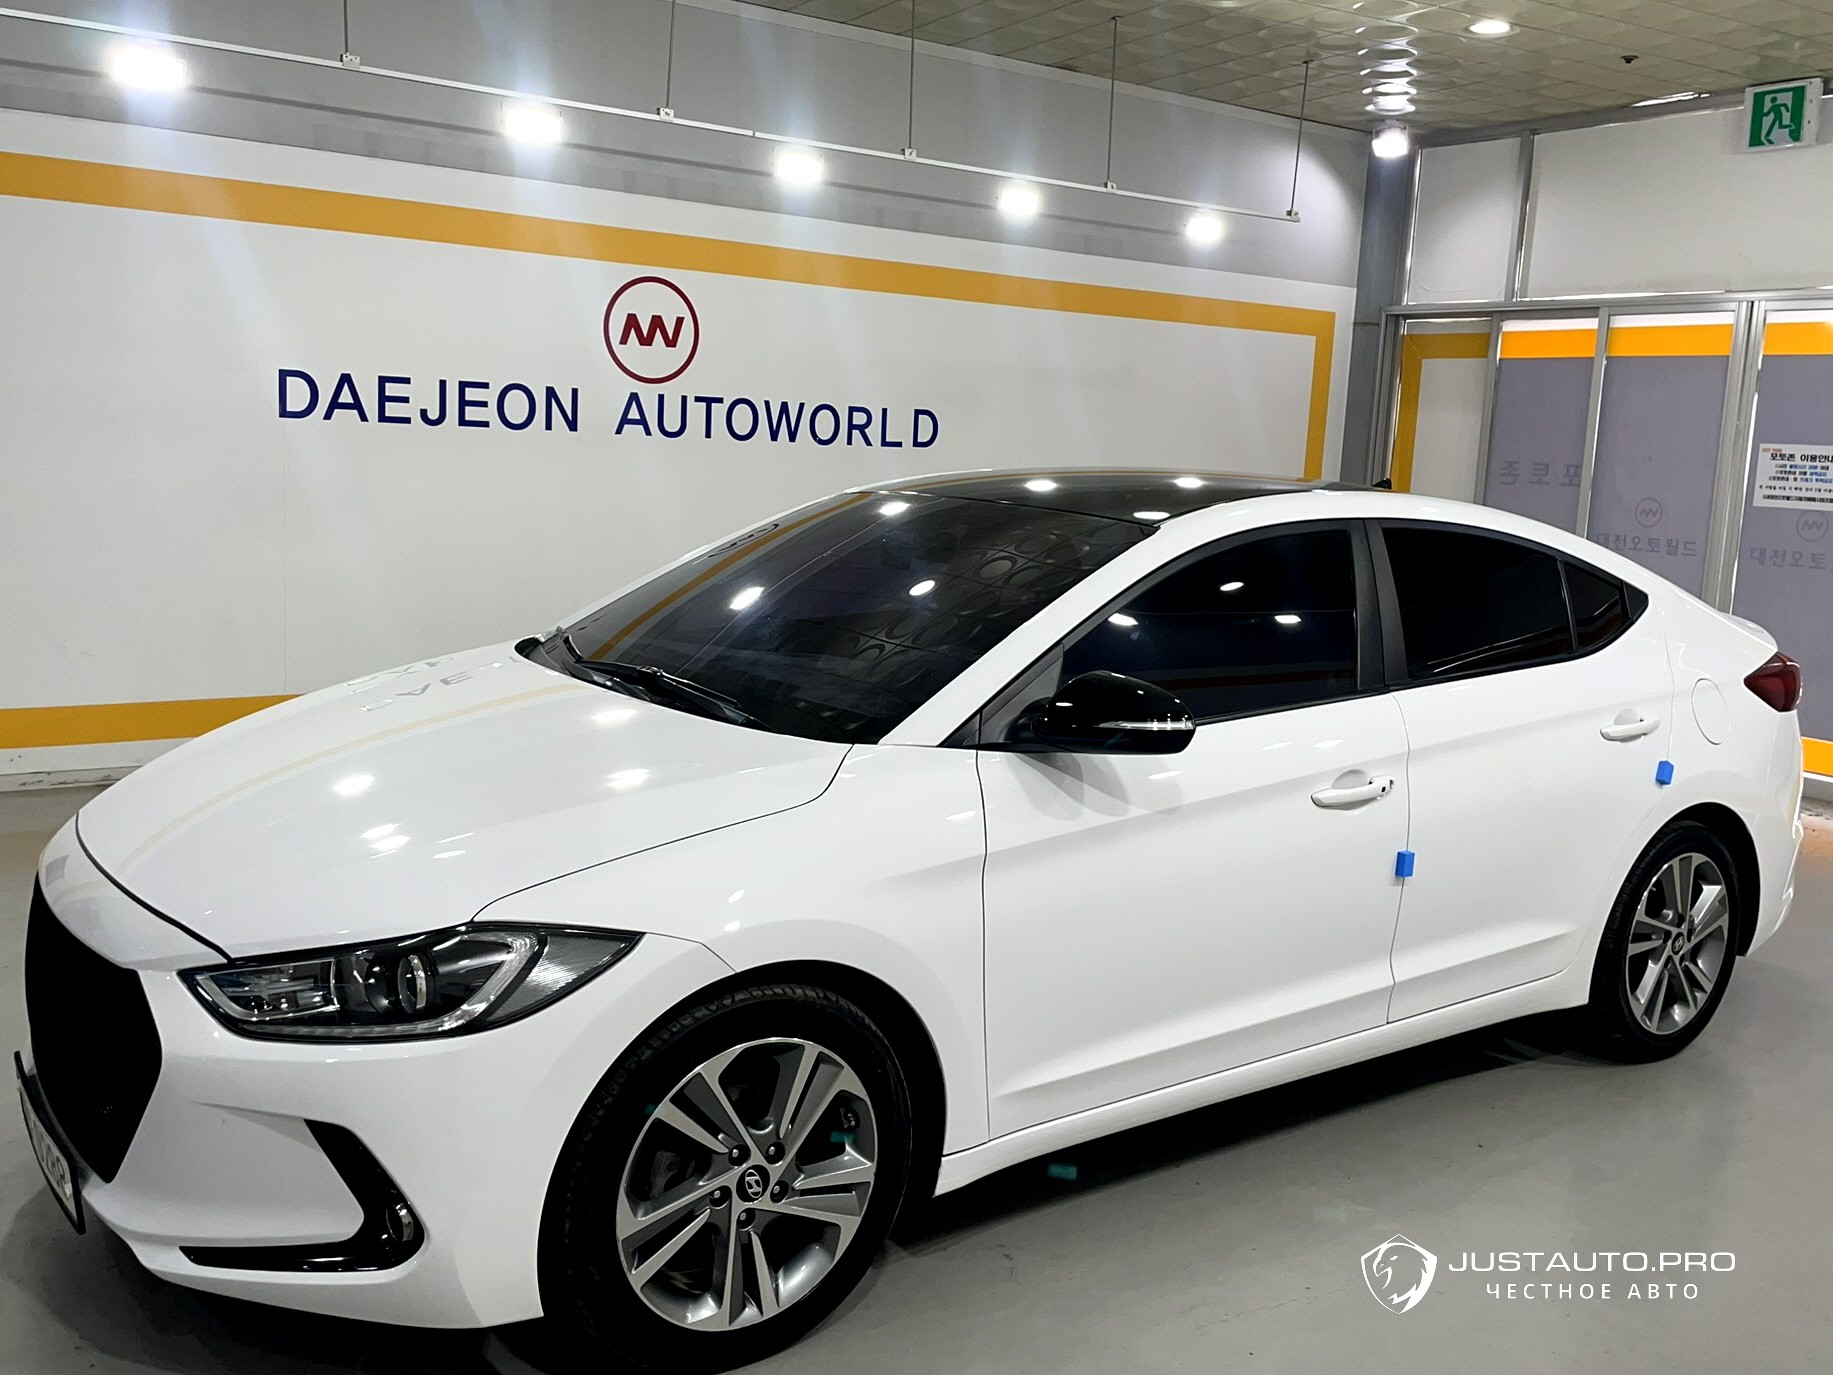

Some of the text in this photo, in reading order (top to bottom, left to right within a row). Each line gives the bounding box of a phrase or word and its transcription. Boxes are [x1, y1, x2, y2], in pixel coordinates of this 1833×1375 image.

[277, 368, 940, 449] DAEJEON AUTOWORLD
[1750, 547, 1833, 571] 대전오토
